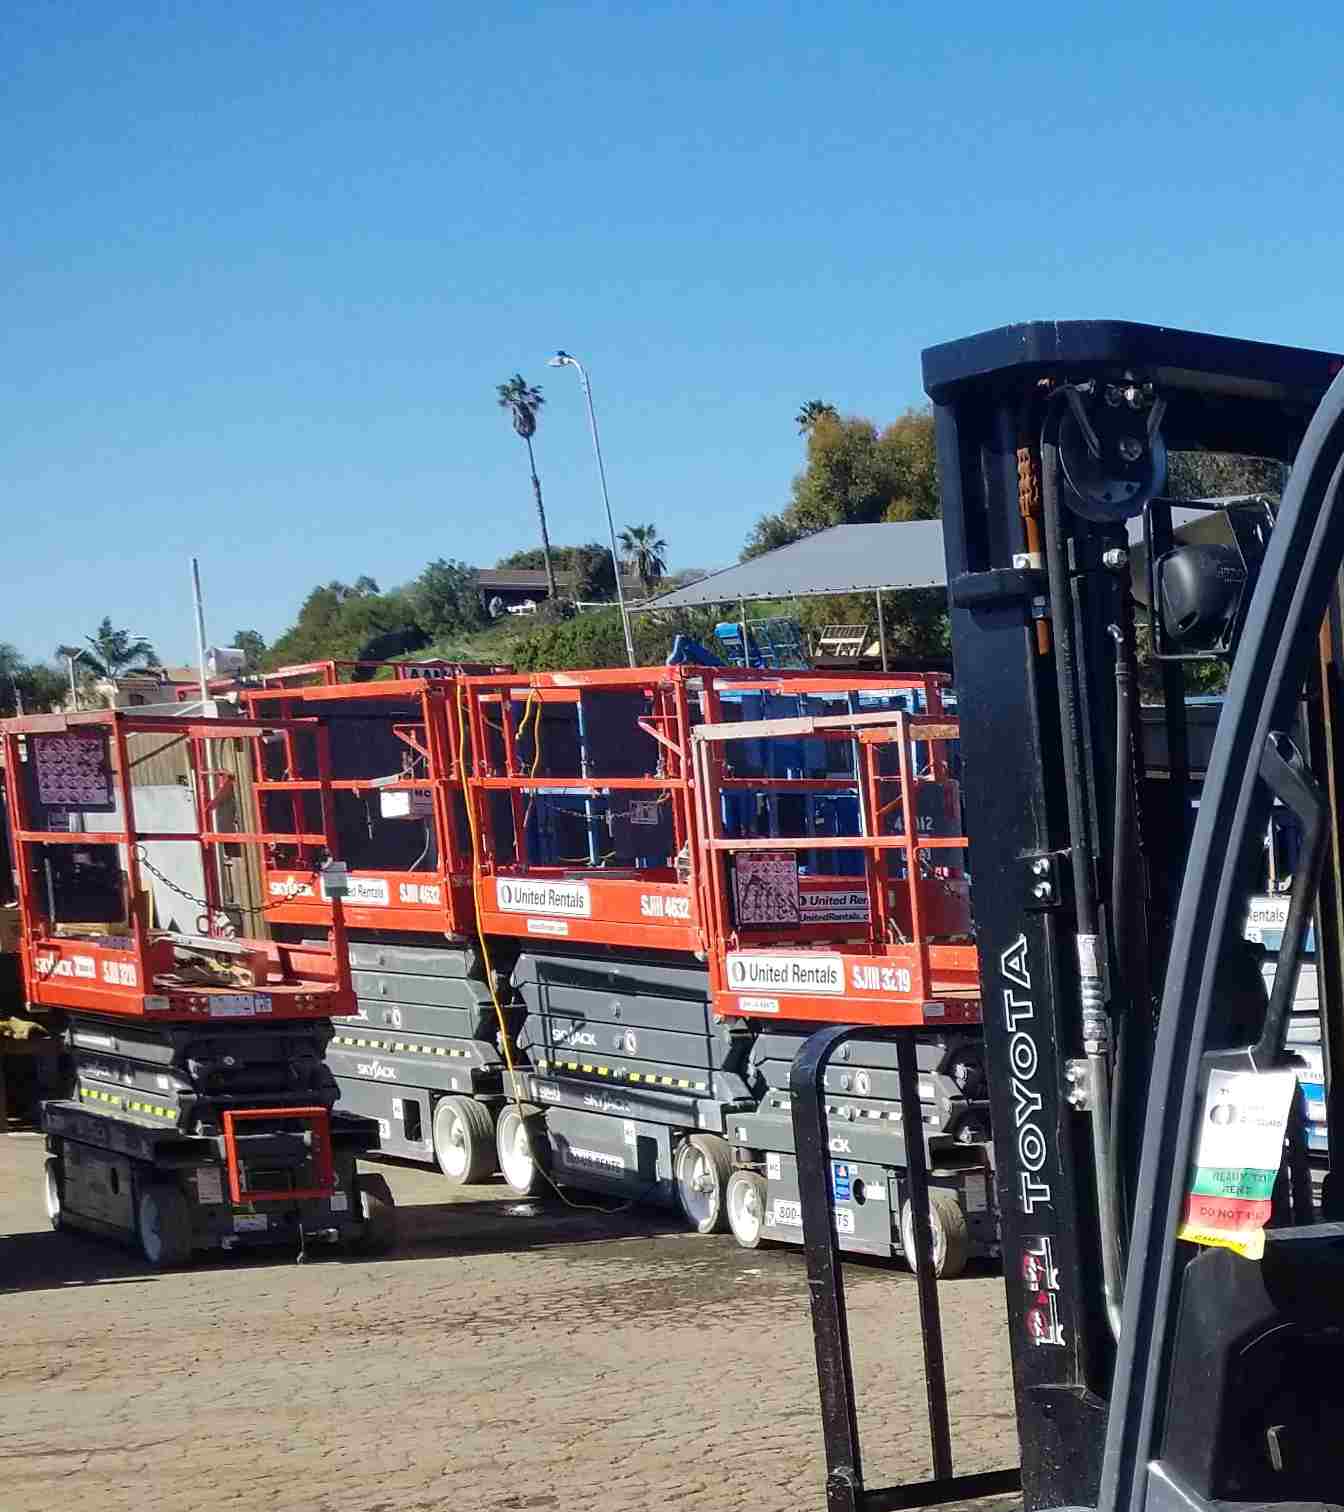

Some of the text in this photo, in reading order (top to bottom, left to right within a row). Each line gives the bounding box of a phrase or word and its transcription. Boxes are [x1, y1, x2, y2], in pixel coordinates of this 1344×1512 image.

[514, 887, 584, 909] United Rentals
[1248, 907, 1286, 922] entals
[750, 963, 838, 985] United Rentals
[357, 1060, 396, 1079] SKYJACK
[1001, 933, 1051, 1214] TOYOTA
